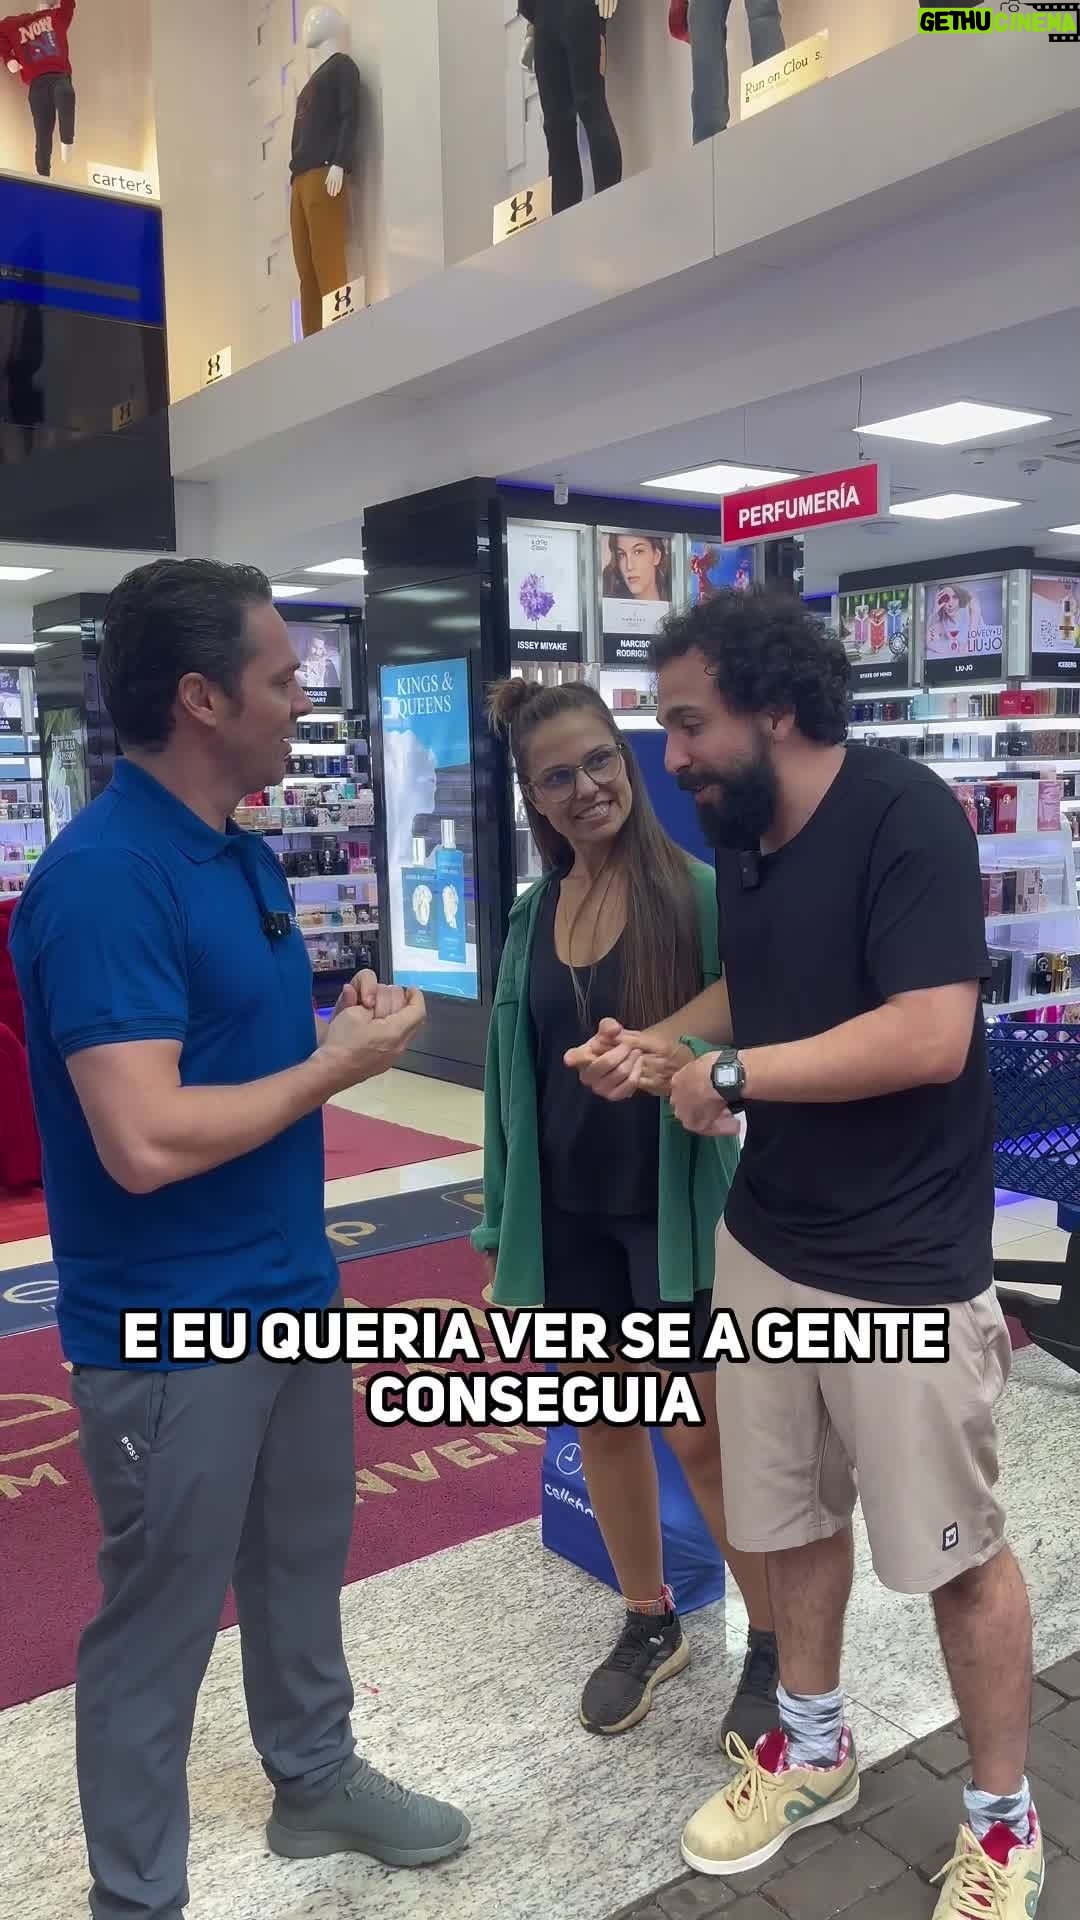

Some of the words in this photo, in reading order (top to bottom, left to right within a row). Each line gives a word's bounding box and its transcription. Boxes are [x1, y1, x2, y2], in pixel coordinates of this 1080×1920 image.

[745, 80, 765, 97] Run
[768, 71, 781, 84] on
[92, 173, 153, 195] carter's
[738, 482, 861, 529] PERFUMERÍA
[517, 640, 539, 650] ISSEY
[540, 641, 568, 651] MIYAKE
[616, 649, 648, 658] RODRIGU
[396, 673, 439, 696] KINGS
[441, 671, 454, 691] &
[399, 694, 452, 720] QUEENS
[121, 1436, 140, 1461] BOSS
